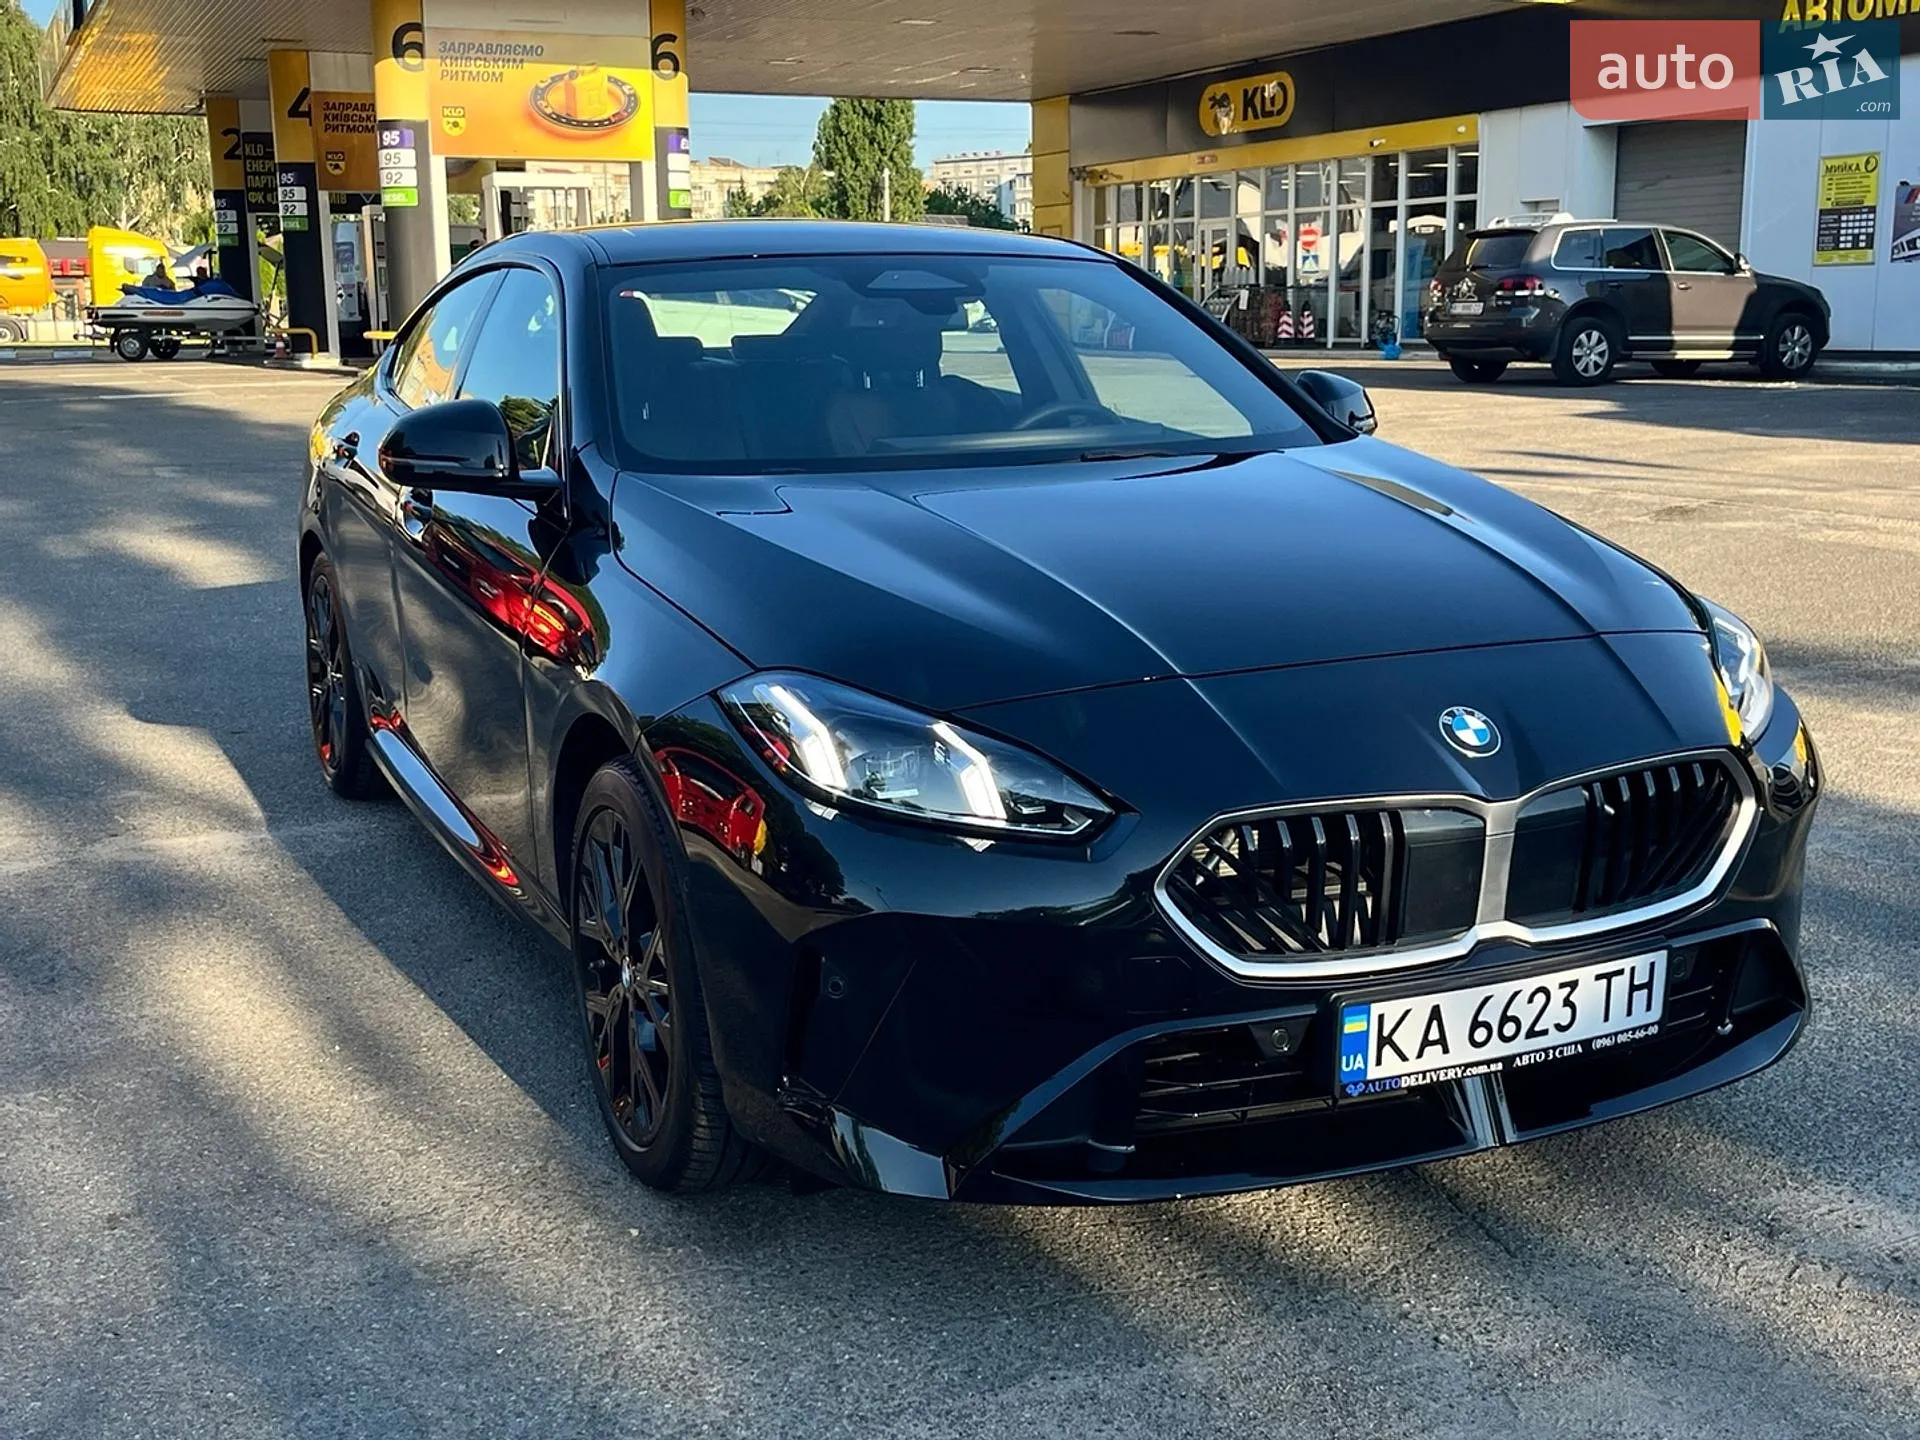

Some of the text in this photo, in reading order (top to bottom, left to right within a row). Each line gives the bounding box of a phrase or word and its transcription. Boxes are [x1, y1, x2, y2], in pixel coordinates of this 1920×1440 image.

[1778, 0, 1920, 34] АВТО
[392, 22, 424, 72] 6
[439, 41, 544, 57] ЗАПРАВЛЯЄМО
[440, 55, 524, 70] КИЇВСЬКИМ
[651, 33, 680, 80] 6
[440, 69, 504, 83] РИТМОМ
[288, 87, 312, 127] 4
[324, 123, 376, 134] РИТМОМ
[221, 128, 242, 159] 2
[382, 130, 400, 146] 95
[383, 152, 401, 166] 95
[1825, 160, 1861, 174] МИЙКА
[281, 172, 294, 184] 95
[385, 171, 403, 185] 92
[281, 189, 295, 199] 95
[283, 204, 297, 214] 92
[1375, 961, 1656, 1067] KA 6623 TH
[1592, 1023, 1659, 1050] (096) 005-66-00
[1341, 1053, 1365, 1072] UA
[1513, 1051, 1545, 1068] АВТО
[1556, 1043, 1583, 1059] США
[1365, 1062, 1503, 1094] AUTODELIVERY.com.ua
